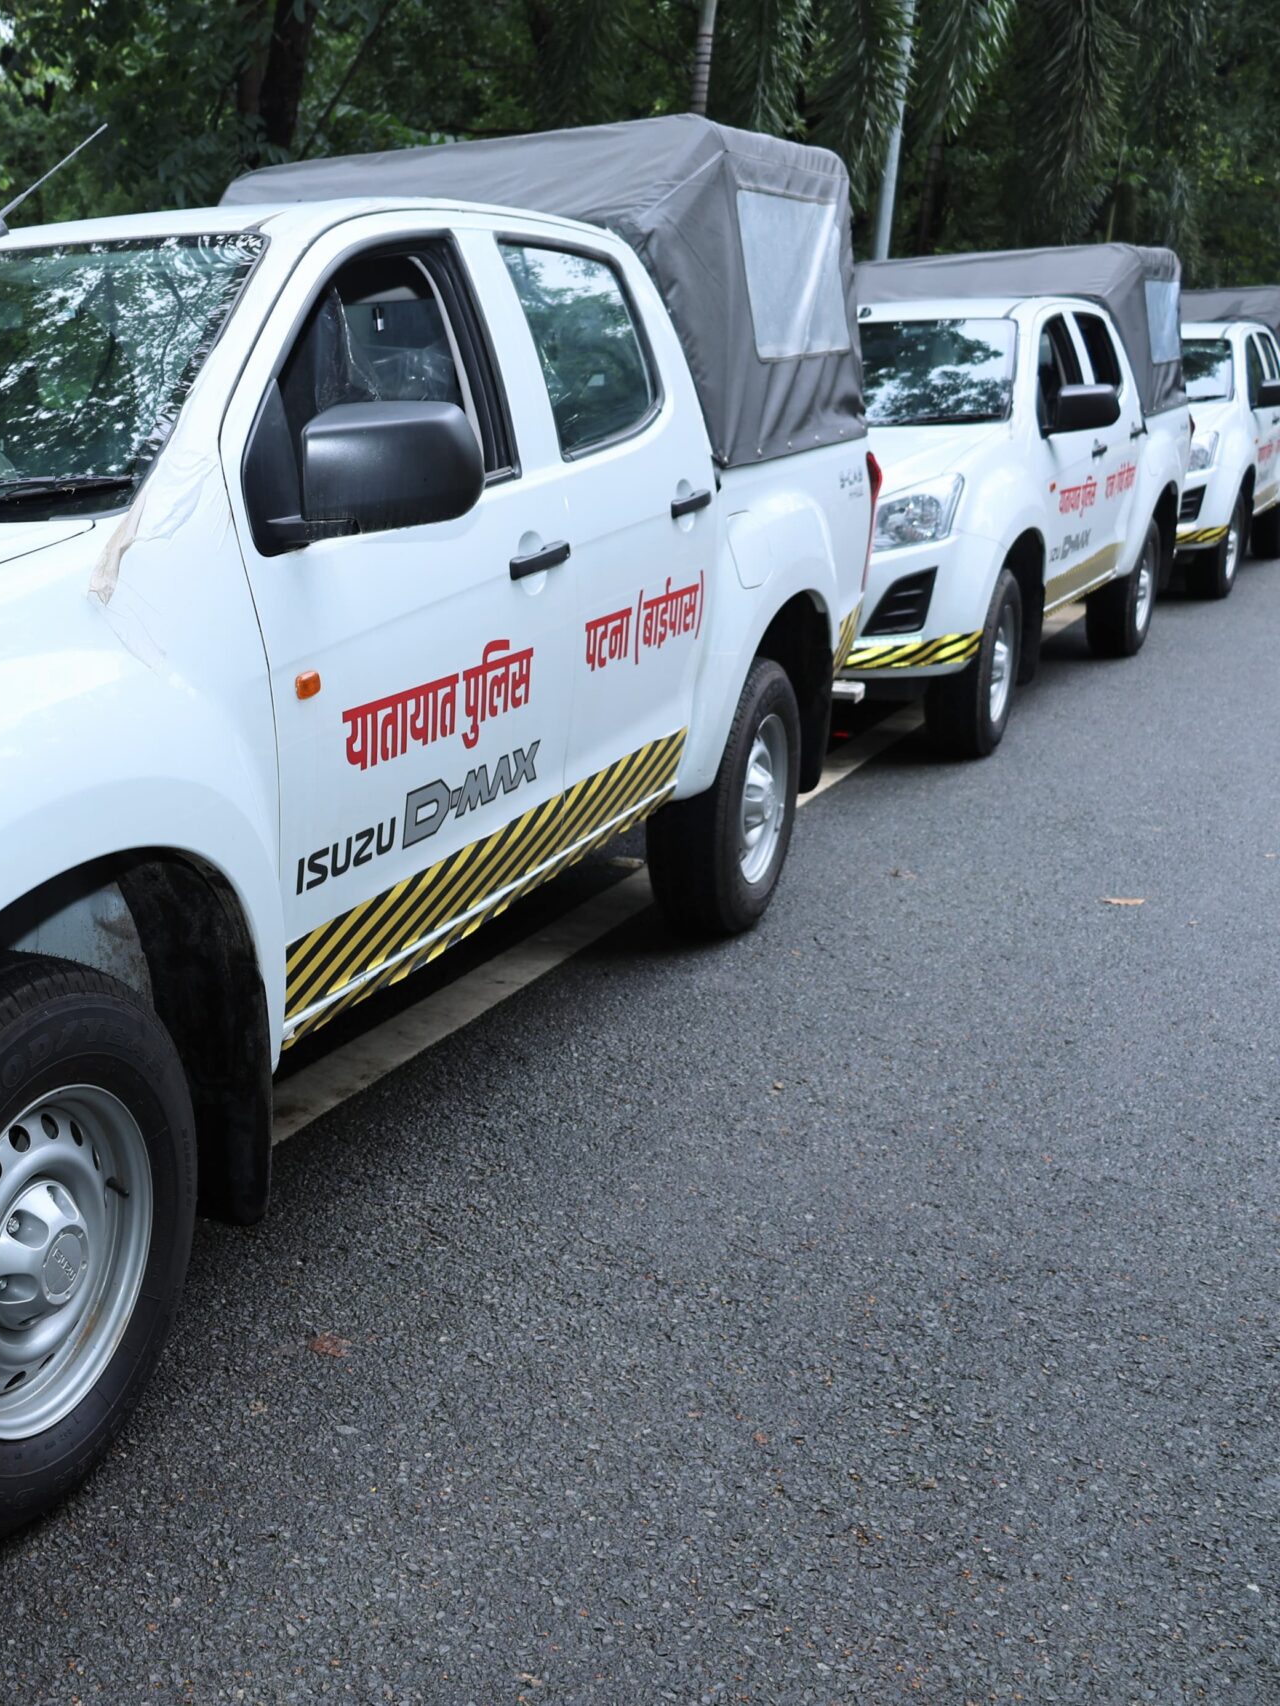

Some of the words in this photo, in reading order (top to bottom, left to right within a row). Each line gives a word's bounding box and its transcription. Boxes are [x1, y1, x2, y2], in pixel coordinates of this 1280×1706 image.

[342, 673, 460, 771] यातायात
[461, 639, 534, 749] पुलिस
[585, 606, 633, 672] पटना
[296, 817, 396, 895] ISUZU
[402, 739, 541, 849] D-MAX
